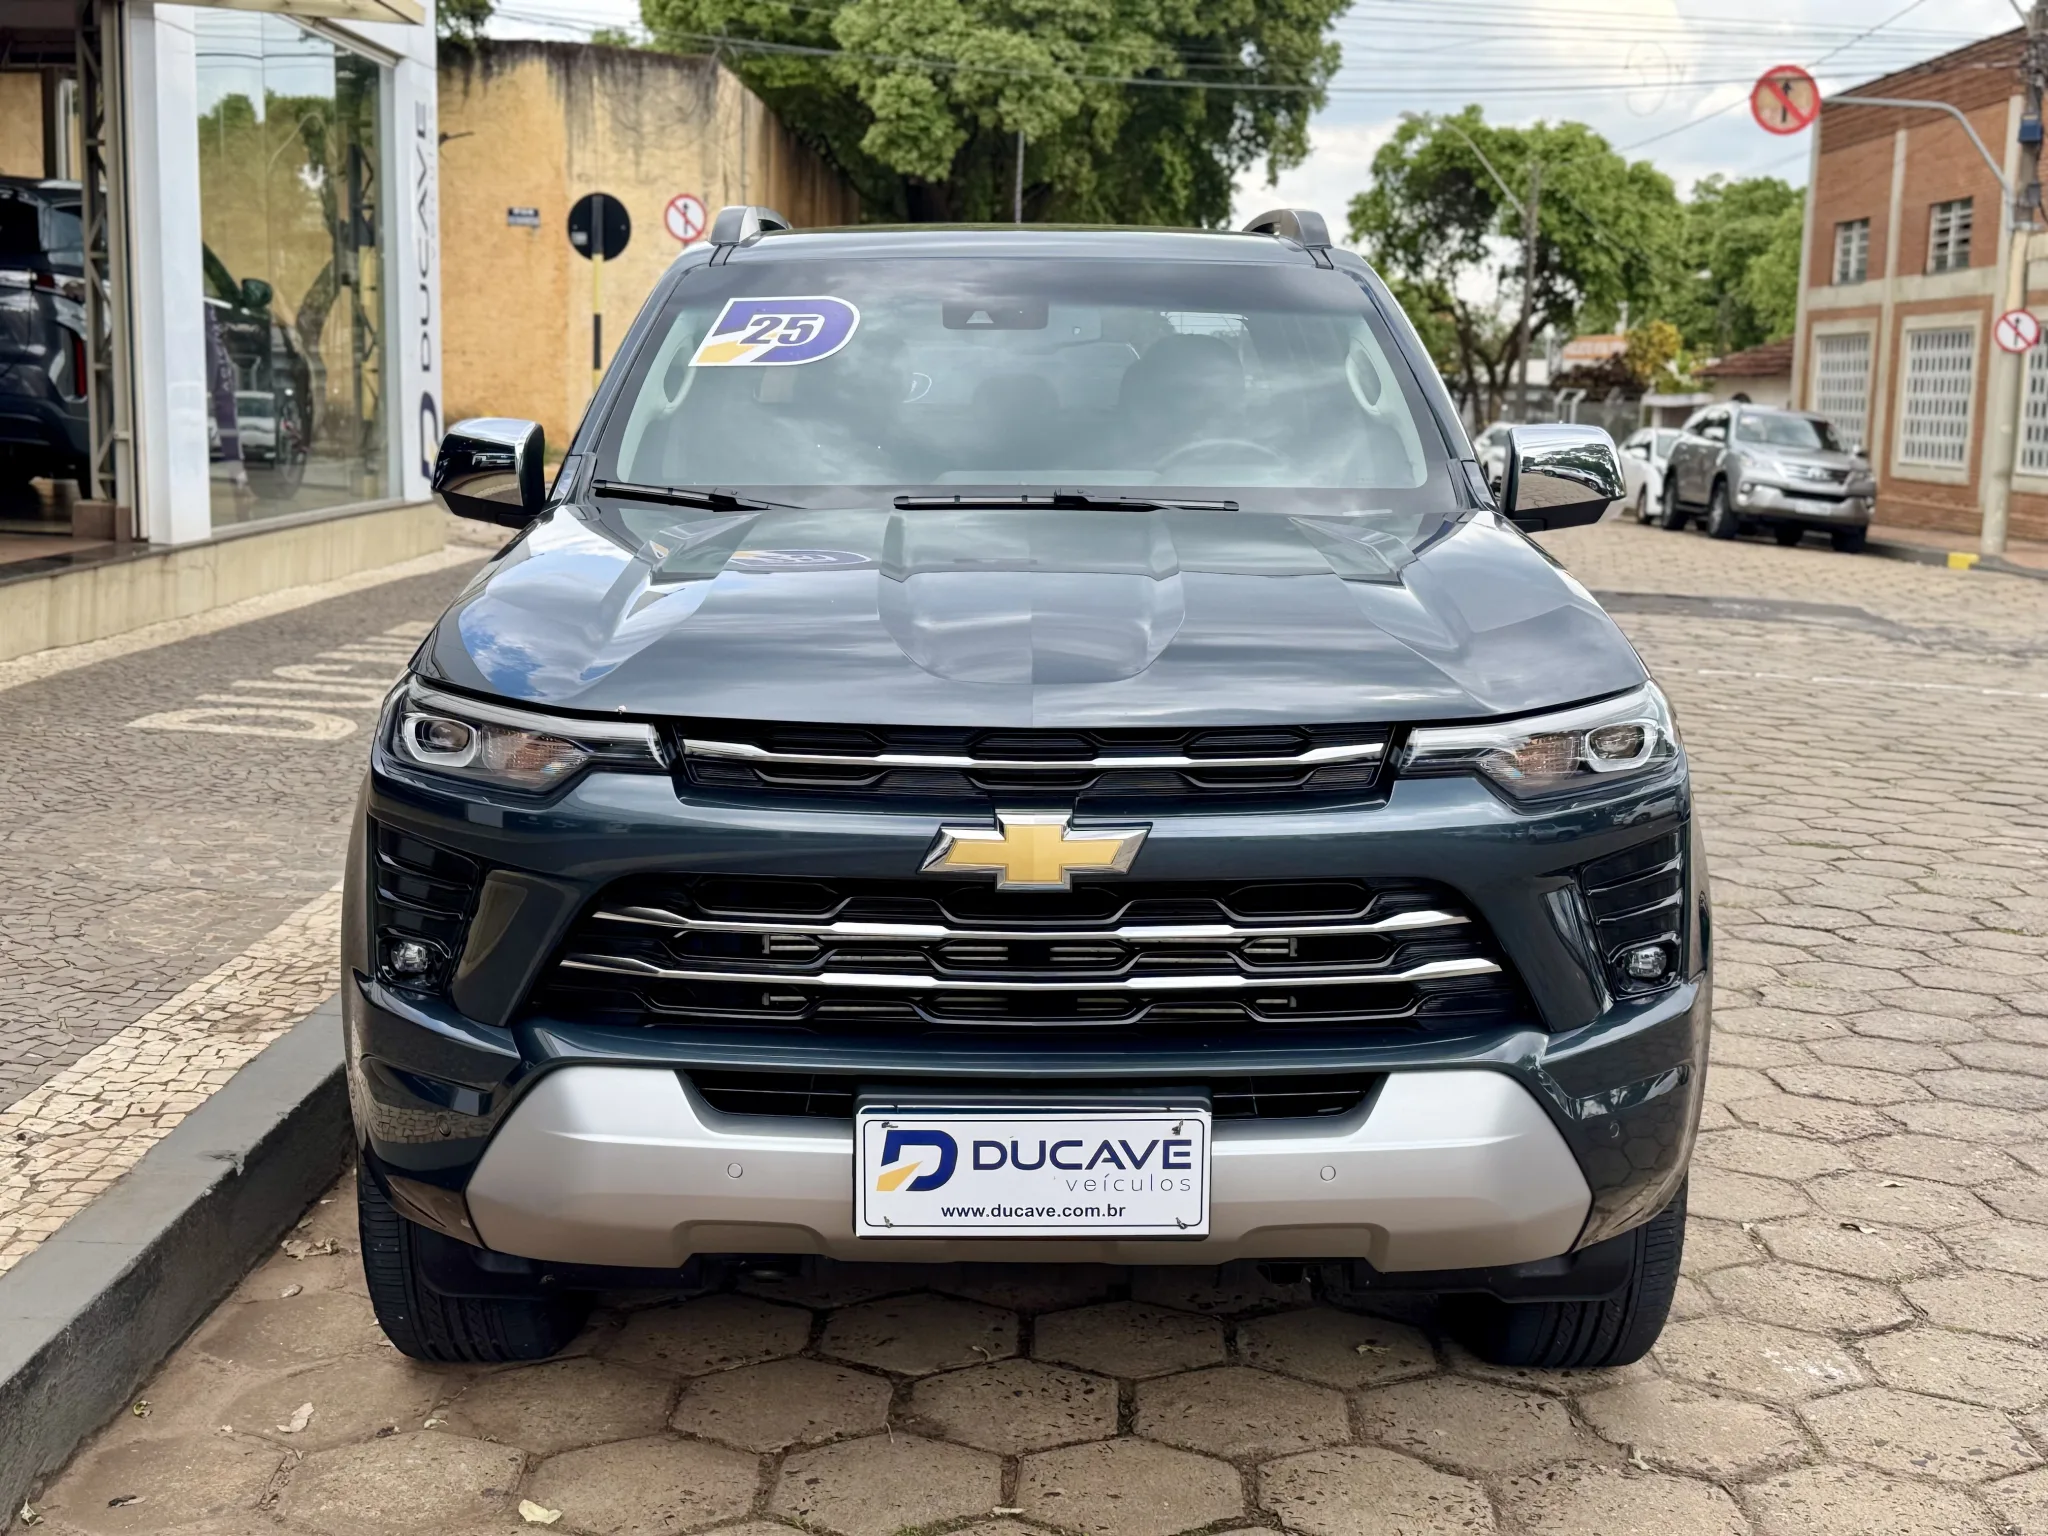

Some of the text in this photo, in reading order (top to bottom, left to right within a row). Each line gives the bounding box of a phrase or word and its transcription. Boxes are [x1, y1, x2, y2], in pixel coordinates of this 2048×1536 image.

[415, 100, 431, 372] DUCAVE
[739, 316, 820, 345] 25
[972, 1139, 1192, 1171] DUCAVE
[1065, 1173, 1191, 1192] veículos
[940, 1204, 1126, 1218] www.ducave.com.br
